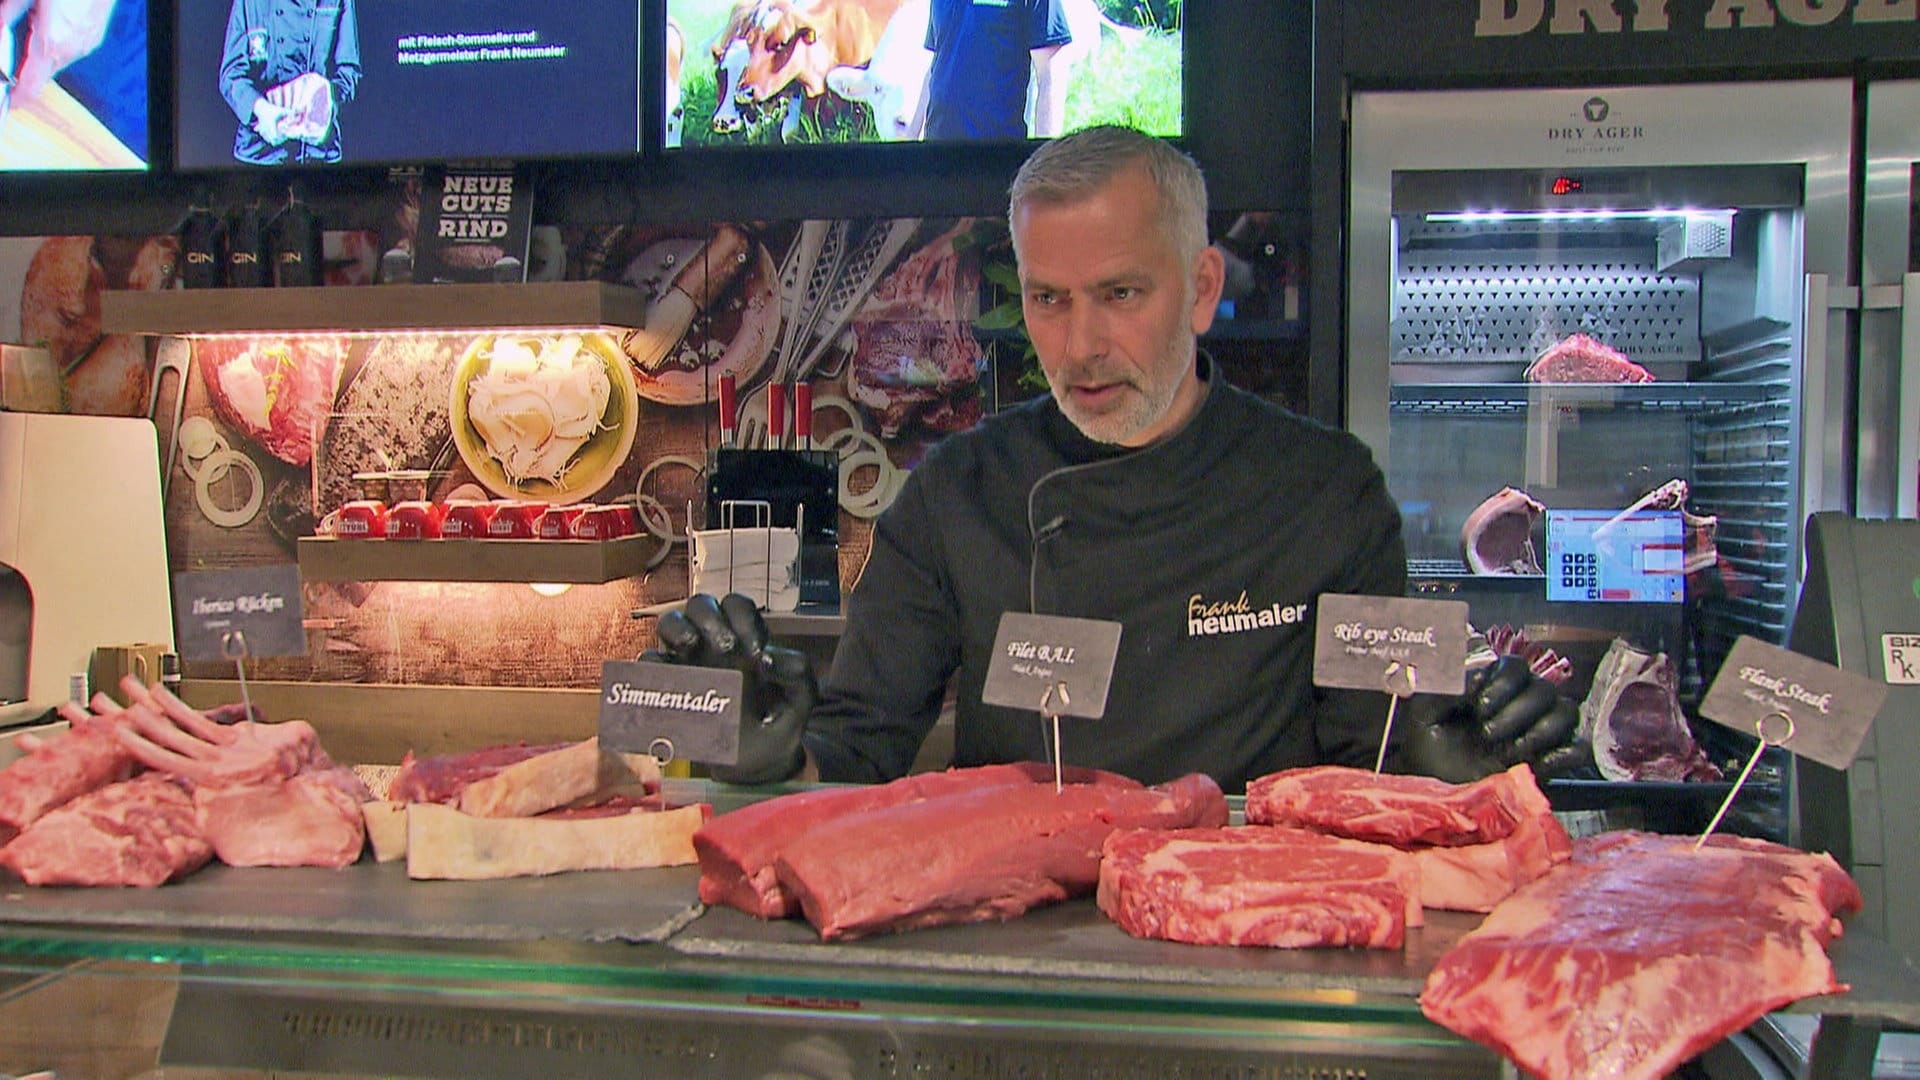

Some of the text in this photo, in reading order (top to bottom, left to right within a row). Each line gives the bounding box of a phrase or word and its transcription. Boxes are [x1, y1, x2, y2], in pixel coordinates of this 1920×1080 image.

[398, 35, 415, 49] mit
[514, 29, 536, 43] und
[398, 48, 480, 65] Metzgermeister
[480, 46, 511, 60] Frank
[1548, 126, 1645, 140] DRY AGER
[443, 175, 514, 194] NEUE
[441, 194, 512, 213] CUTS
[437, 218, 508, 237] RIND
[187, 251, 215, 264] GIN
[231, 251, 257, 264] GIN
[1333, 622, 1438, 647] Rib eye Steak
[1007, 640, 1037, 660] Filet
[606, 682, 731, 714] Simmentaler
